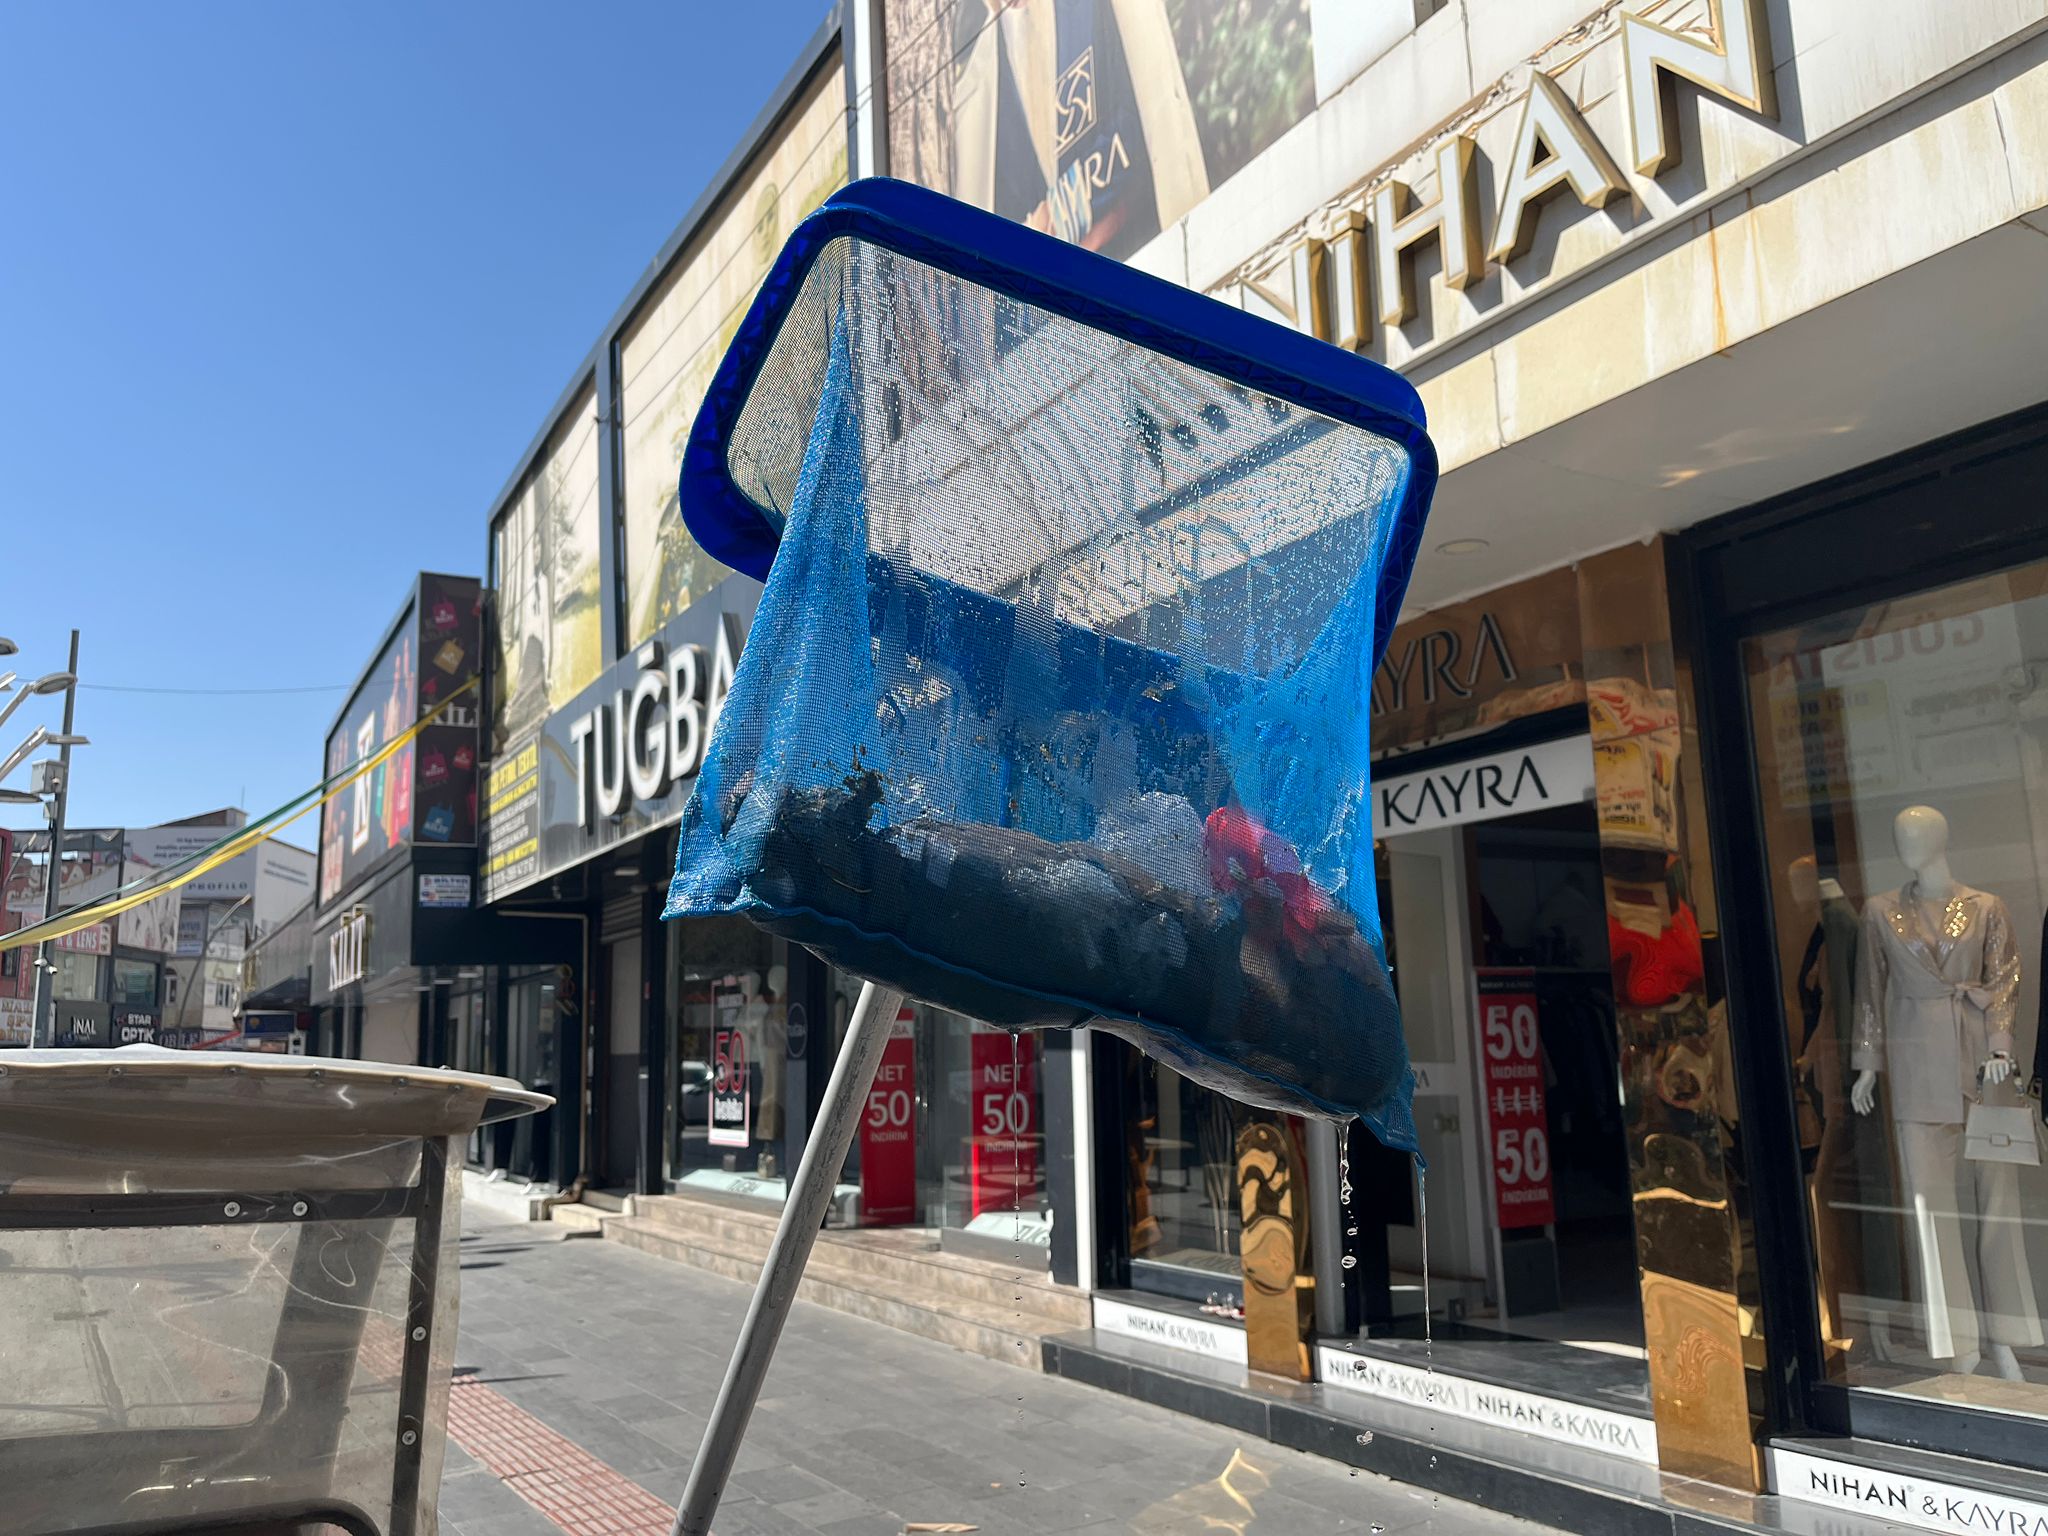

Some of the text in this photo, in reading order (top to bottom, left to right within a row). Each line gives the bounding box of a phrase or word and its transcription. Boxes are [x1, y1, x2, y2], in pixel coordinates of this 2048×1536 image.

[1381, 755, 1549, 828] KAYRA
[1486, 1004, 1538, 1060] 50
[714, 1031, 745, 1095] 50
[984, 1064, 1024, 1083] NET
[868, 1090, 910, 1128] 50
[982, 1092, 1030, 1135] 50
[1497, 1127, 1549, 1184] 50
[1565, 1412, 1640, 1449] KAYRA
